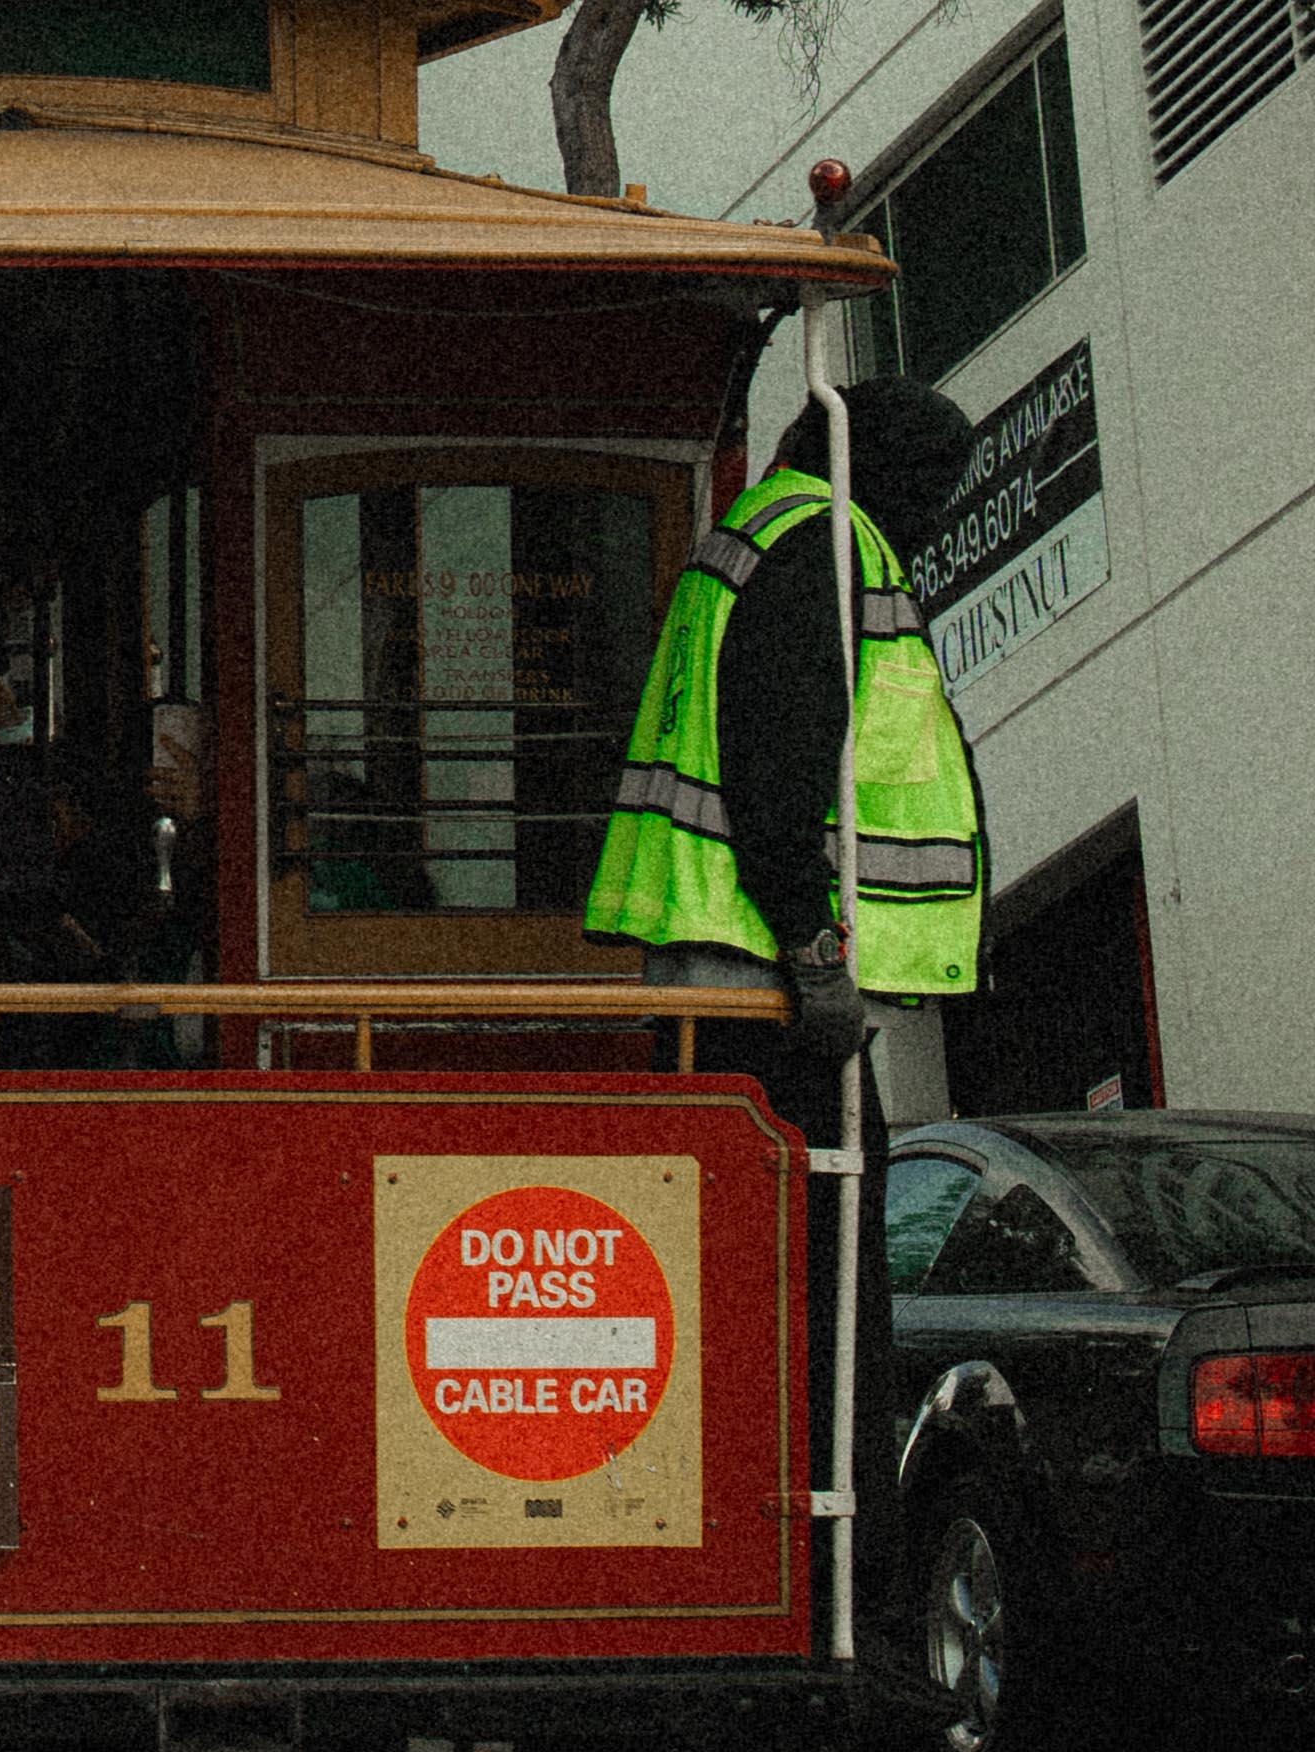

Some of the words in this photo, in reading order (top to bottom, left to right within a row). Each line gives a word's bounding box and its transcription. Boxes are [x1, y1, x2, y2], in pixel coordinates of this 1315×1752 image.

[1000, 356, 1089, 467] AVAILABLE
[912, 467, 1037, 603] 66.349.6074
[942, 533, 1070, 684] CHESTNUT
[460, 1228, 525, 1268] DO
[533, 1228, 624, 1267] NOT
[487, 1271, 596, 1309] PASS
[95, 1299, 282, 1402] 11
[434, 1378, 559, 1415] CABLE
[570, 1377, 648, 1413] CAR
